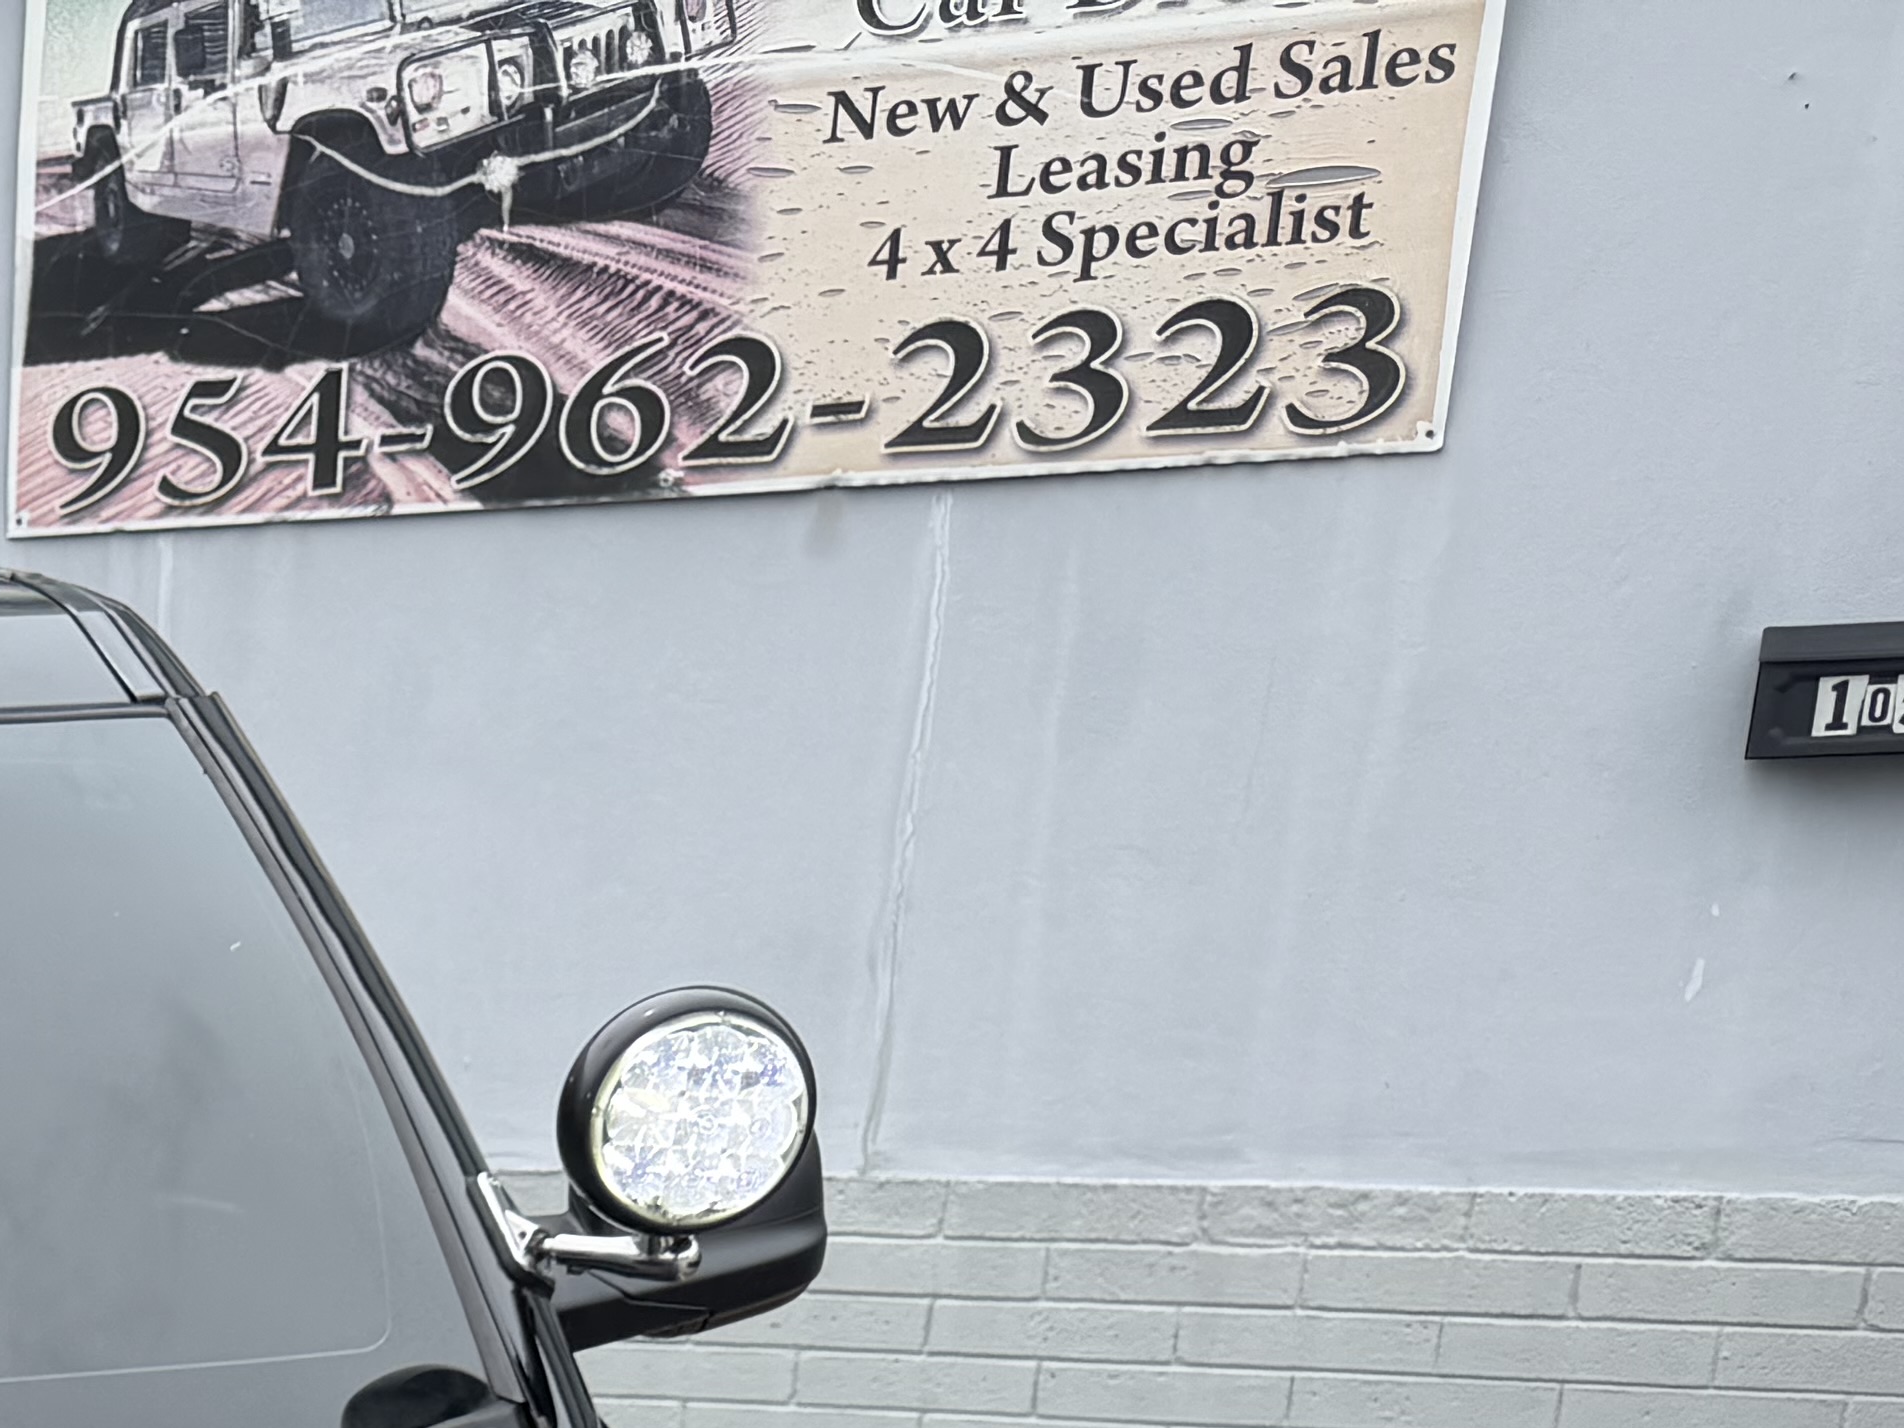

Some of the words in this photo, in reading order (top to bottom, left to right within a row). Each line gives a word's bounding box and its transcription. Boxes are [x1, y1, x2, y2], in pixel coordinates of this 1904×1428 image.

[823, 85, 980, 145] New
[994, 70, 1049, 127] &
[1077, 43, 1254, 119] Used
[1273, 29, 1456, 101] Sales
[987, 131, 1261, 199] Leasing
[1036, 191, 1373, 283] Specialist
[50, 282, 1407, 516] 954-962-2323
[1824, 678, 1904, 732] 10
